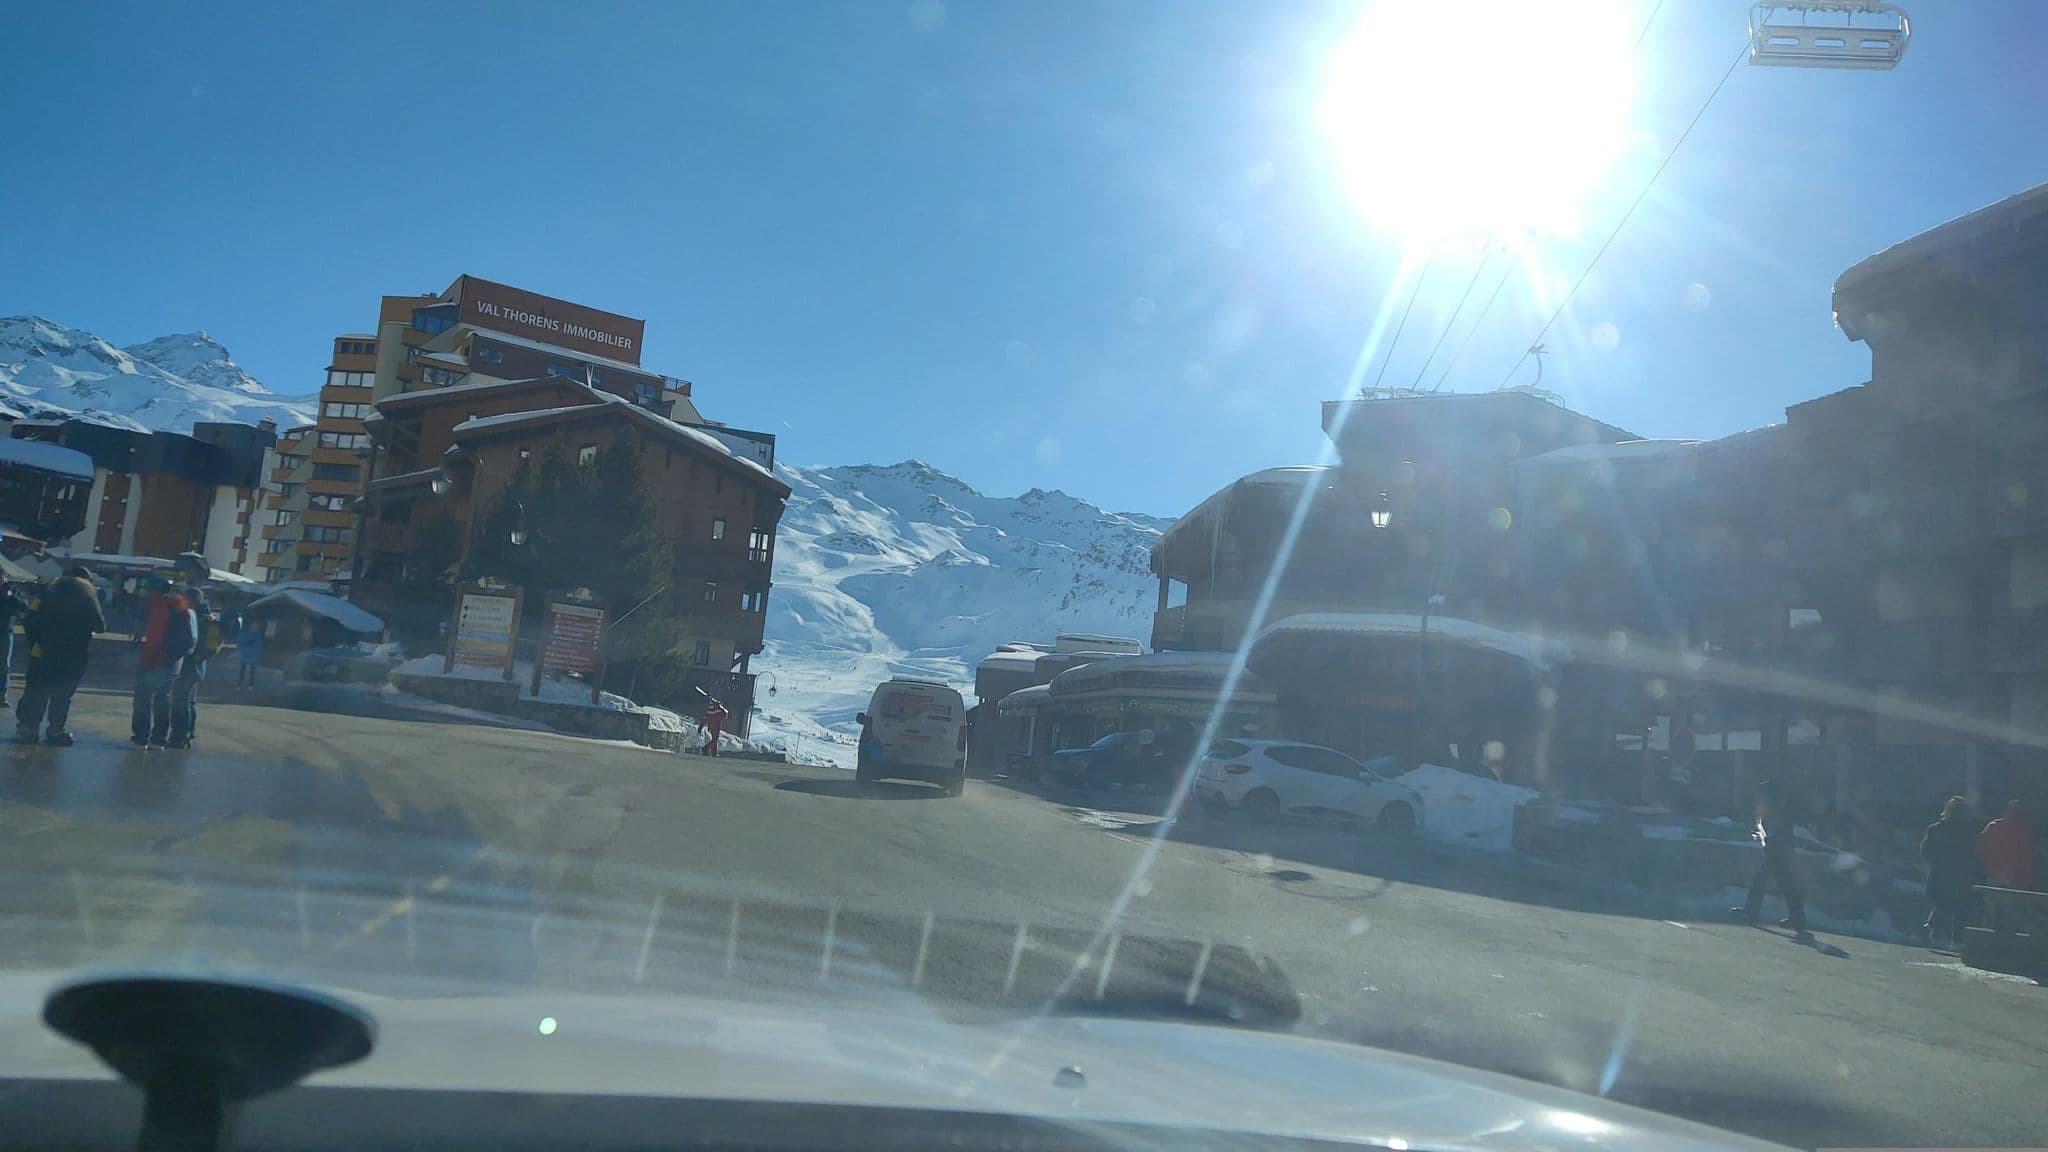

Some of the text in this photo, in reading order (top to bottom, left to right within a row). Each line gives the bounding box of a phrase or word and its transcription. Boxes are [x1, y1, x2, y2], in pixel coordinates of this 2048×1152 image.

[477, 300, 632, 350] VAL THORENS IMMOBILIER
